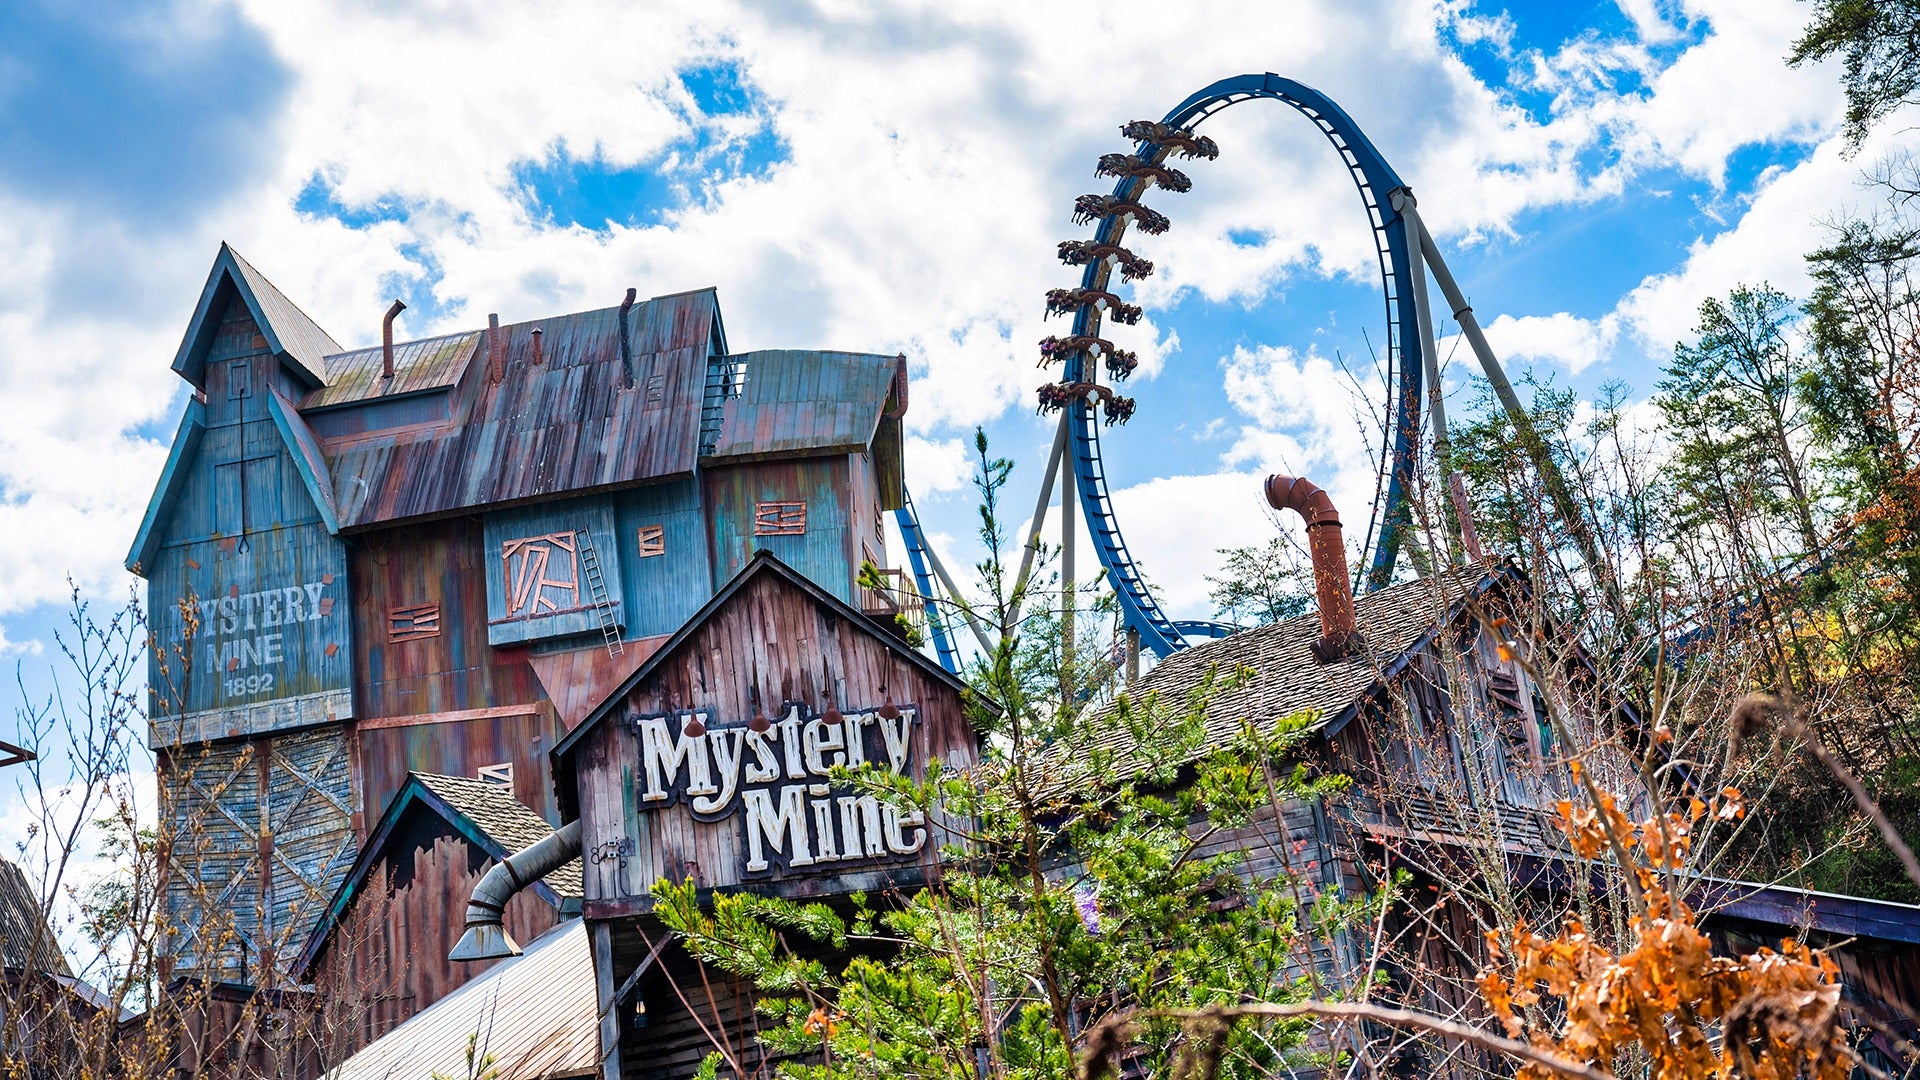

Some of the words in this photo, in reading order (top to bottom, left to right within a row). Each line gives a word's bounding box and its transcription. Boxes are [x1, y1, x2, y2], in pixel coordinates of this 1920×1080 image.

[206, 633, 283, 674] MINE
[224, 673, 273, 697] 1892
[637, 705, 915, 814] Mystery
[742, 782, 926, 872] Mine
